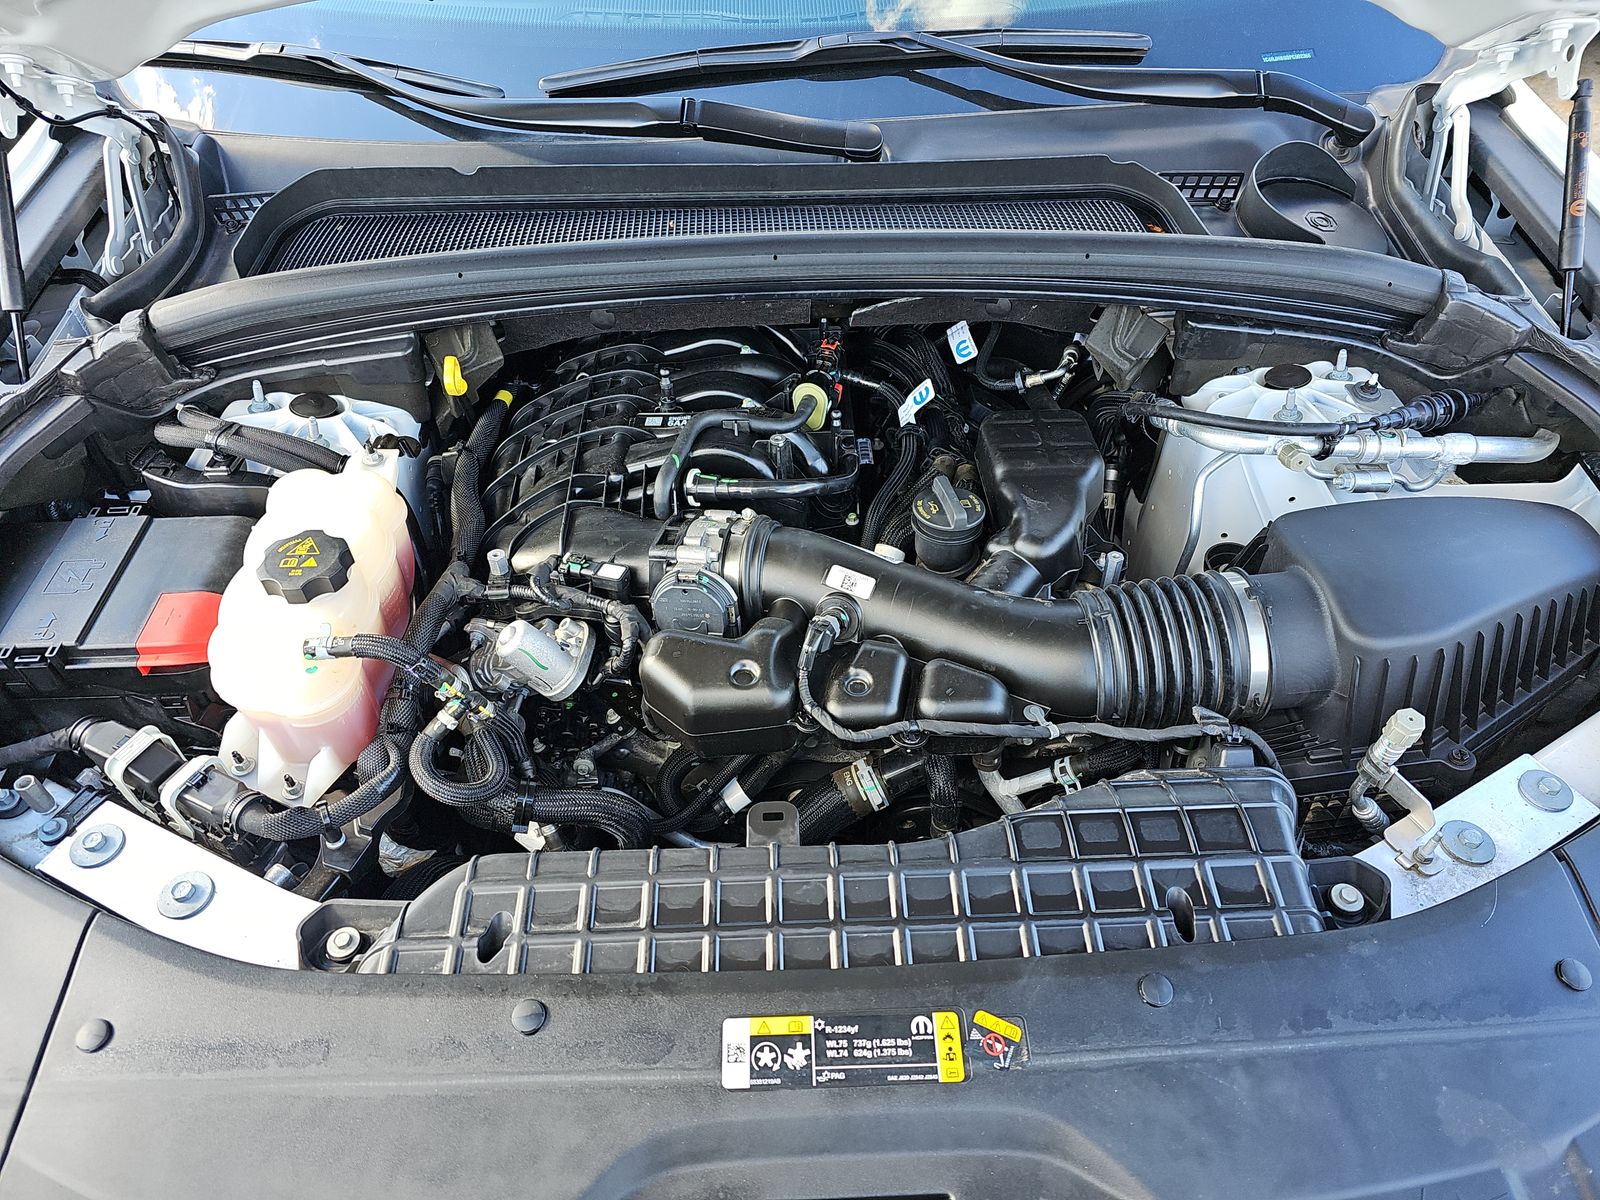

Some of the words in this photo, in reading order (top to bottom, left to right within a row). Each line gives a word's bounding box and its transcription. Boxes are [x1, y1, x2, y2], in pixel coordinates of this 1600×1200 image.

[843, 771, 853, 786] ENG
[825, 1025, 859, 1034] R-1234yf
[826, 1040, 848, 1048] WL75
[853, 1040, 872, 1048] 737g
[873, 1039, 896, 1047] (1.625
[897, 1038, 912, 1047] lbs)
[853, 1049, 872, 1057] 624g
[874, 1048, 897, 1057] (1.375
[898, 1048, 913, 1056] lbs)
[831, 1072, 845, 1080] PAG
